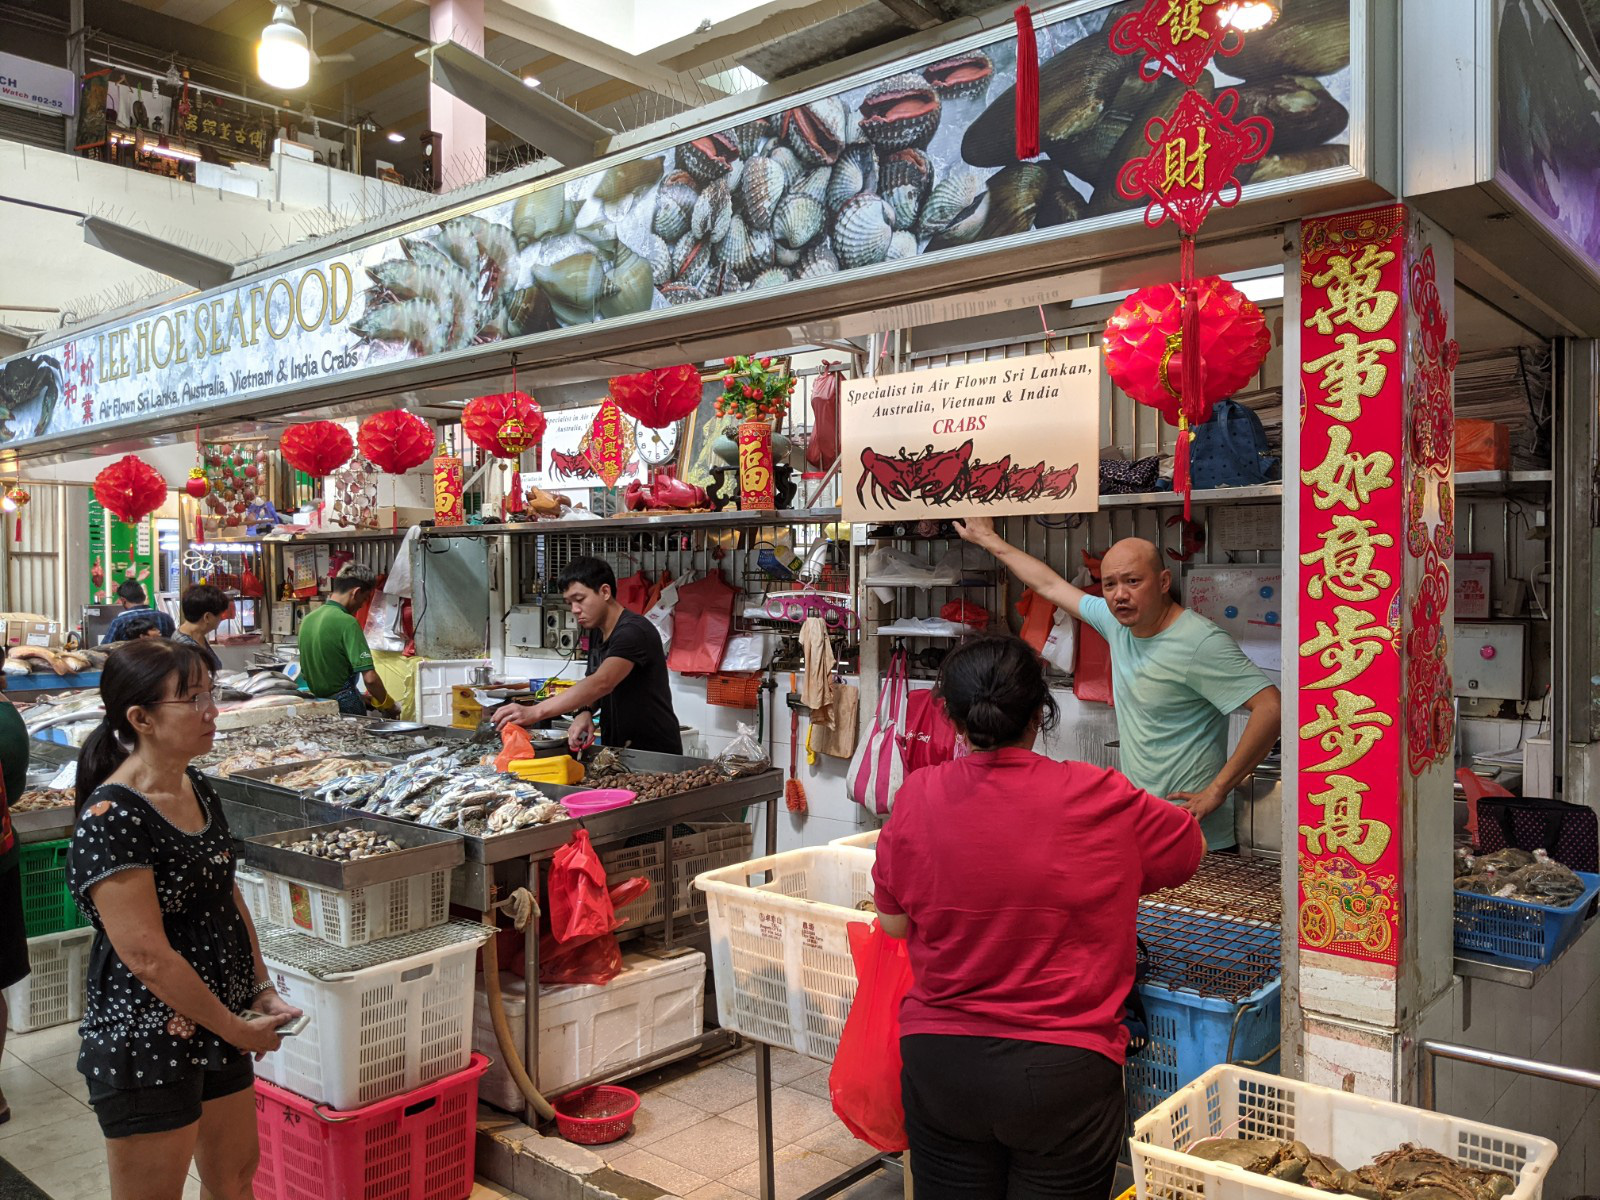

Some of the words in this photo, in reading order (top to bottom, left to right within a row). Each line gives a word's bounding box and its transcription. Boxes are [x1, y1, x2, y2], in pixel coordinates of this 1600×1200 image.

[2, 87, 29, 99] Watch
[99, 327, 131, 384] LEE
[136, 311, 188, 374] HOE
[194, 261, 353, 359] SEAFOOD
[99, 401, 113, 420] Air
[113, 397, 136, 417] Flown
[137, 392, 150, 412] Sri
[151, 387, 181, 409] Lanka,
[181, 375, 229, 405] Australia,
[229, 369, 274, 393] Vietnam
[276, 359, 288, 383] &
[290, 353, 319, 381] India
[321, 345, 359, 374] Crabs
[847, 384, 908, 406] Specialist
[911, 380, 924, 395] in
[928, 379, 950, 393] Air
[955, 373, 997, 390] Flown
[1003, 368, 1025, 384] Sri
[1031, 363, 1093, 381] Lankan,
[871, 400, 935, 419] Australia,
[942, 394, 996, 411] Vietnam
[1002, 391, 1014, 403] &
[1020, 385, 1060, 402] India
[602, 405, 620, 478] 生意興隆
[932, 414, 988, 435] CRABS
[739, 440, 769, 493] 福
[1299, 243, 1399, 865] 萬事如意步步高
